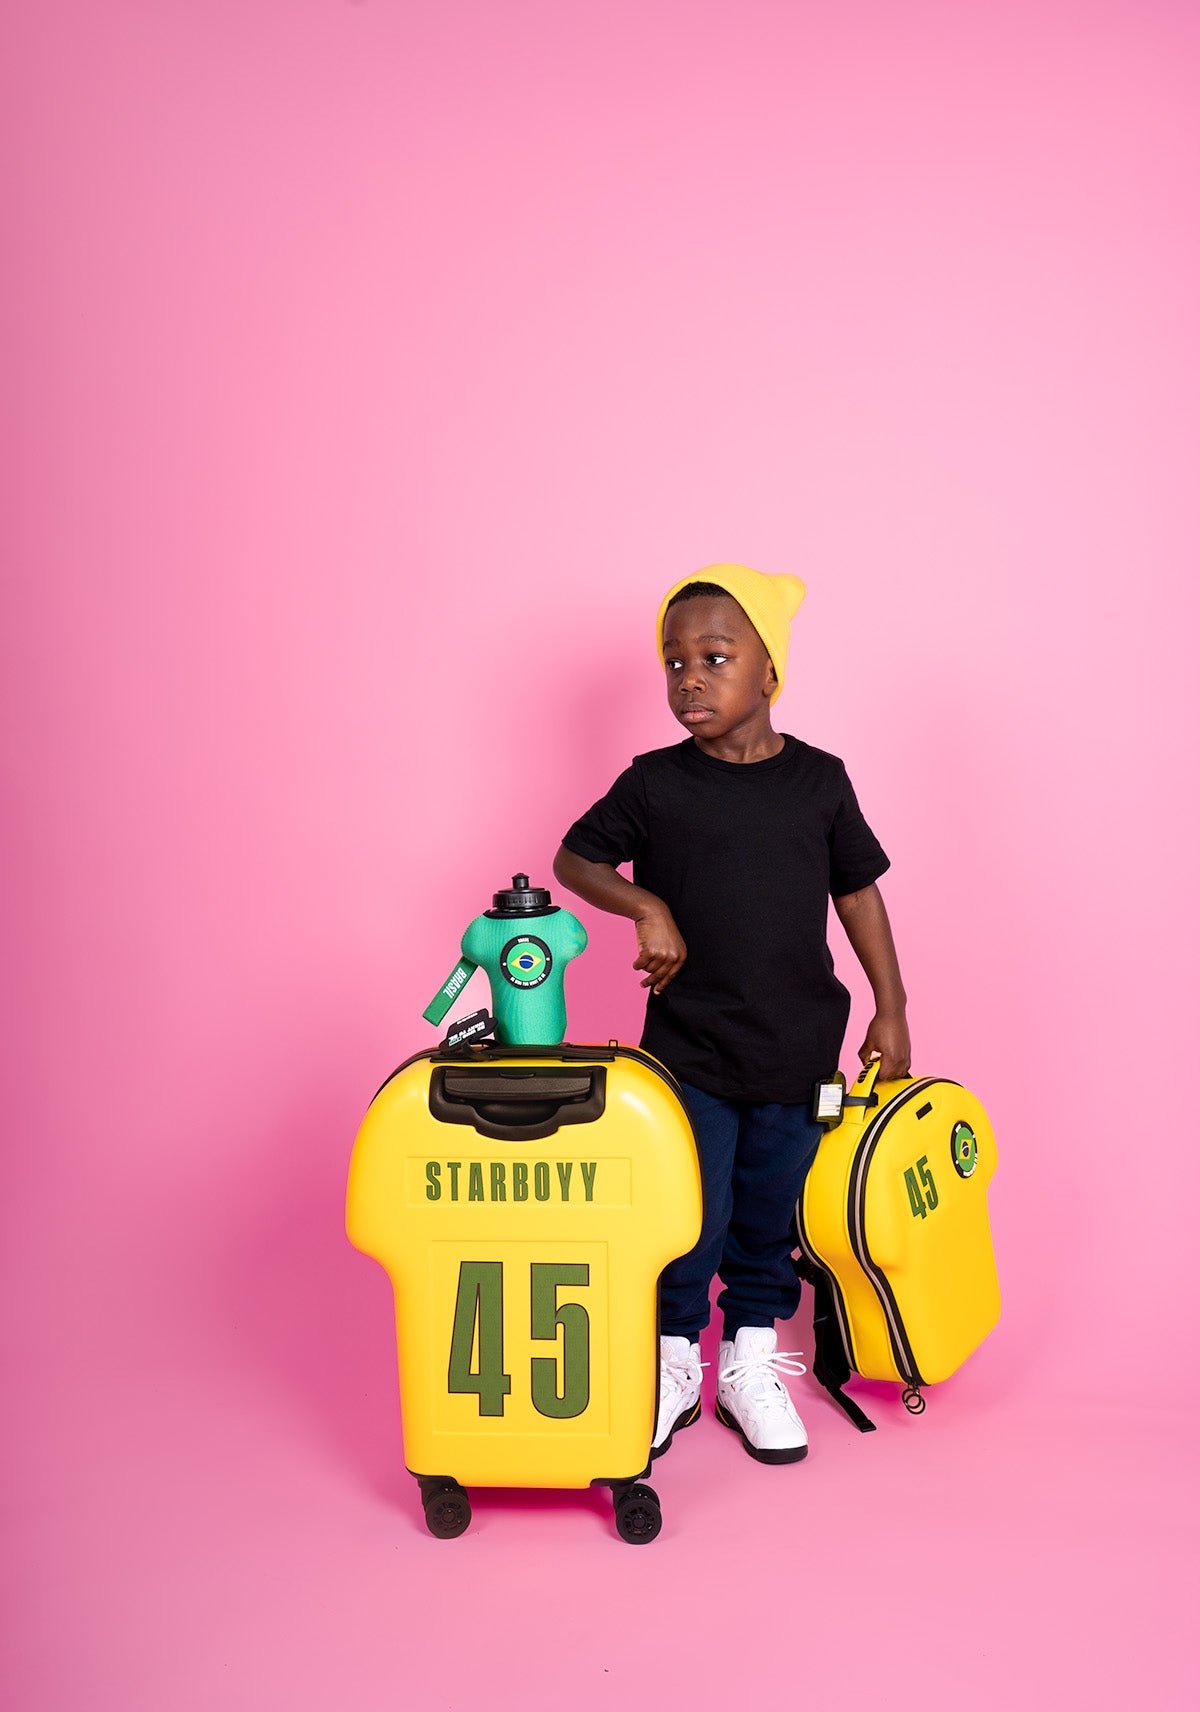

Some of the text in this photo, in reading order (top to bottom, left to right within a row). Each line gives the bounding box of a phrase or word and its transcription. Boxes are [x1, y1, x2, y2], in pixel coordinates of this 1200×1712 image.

[442, 967, 467, 998] BRASIL
[425, 1161, 597, 1201] STARBOYY
[903, 1155, 938, 1219] 45
[448, 1261, 590, 1419] 45
